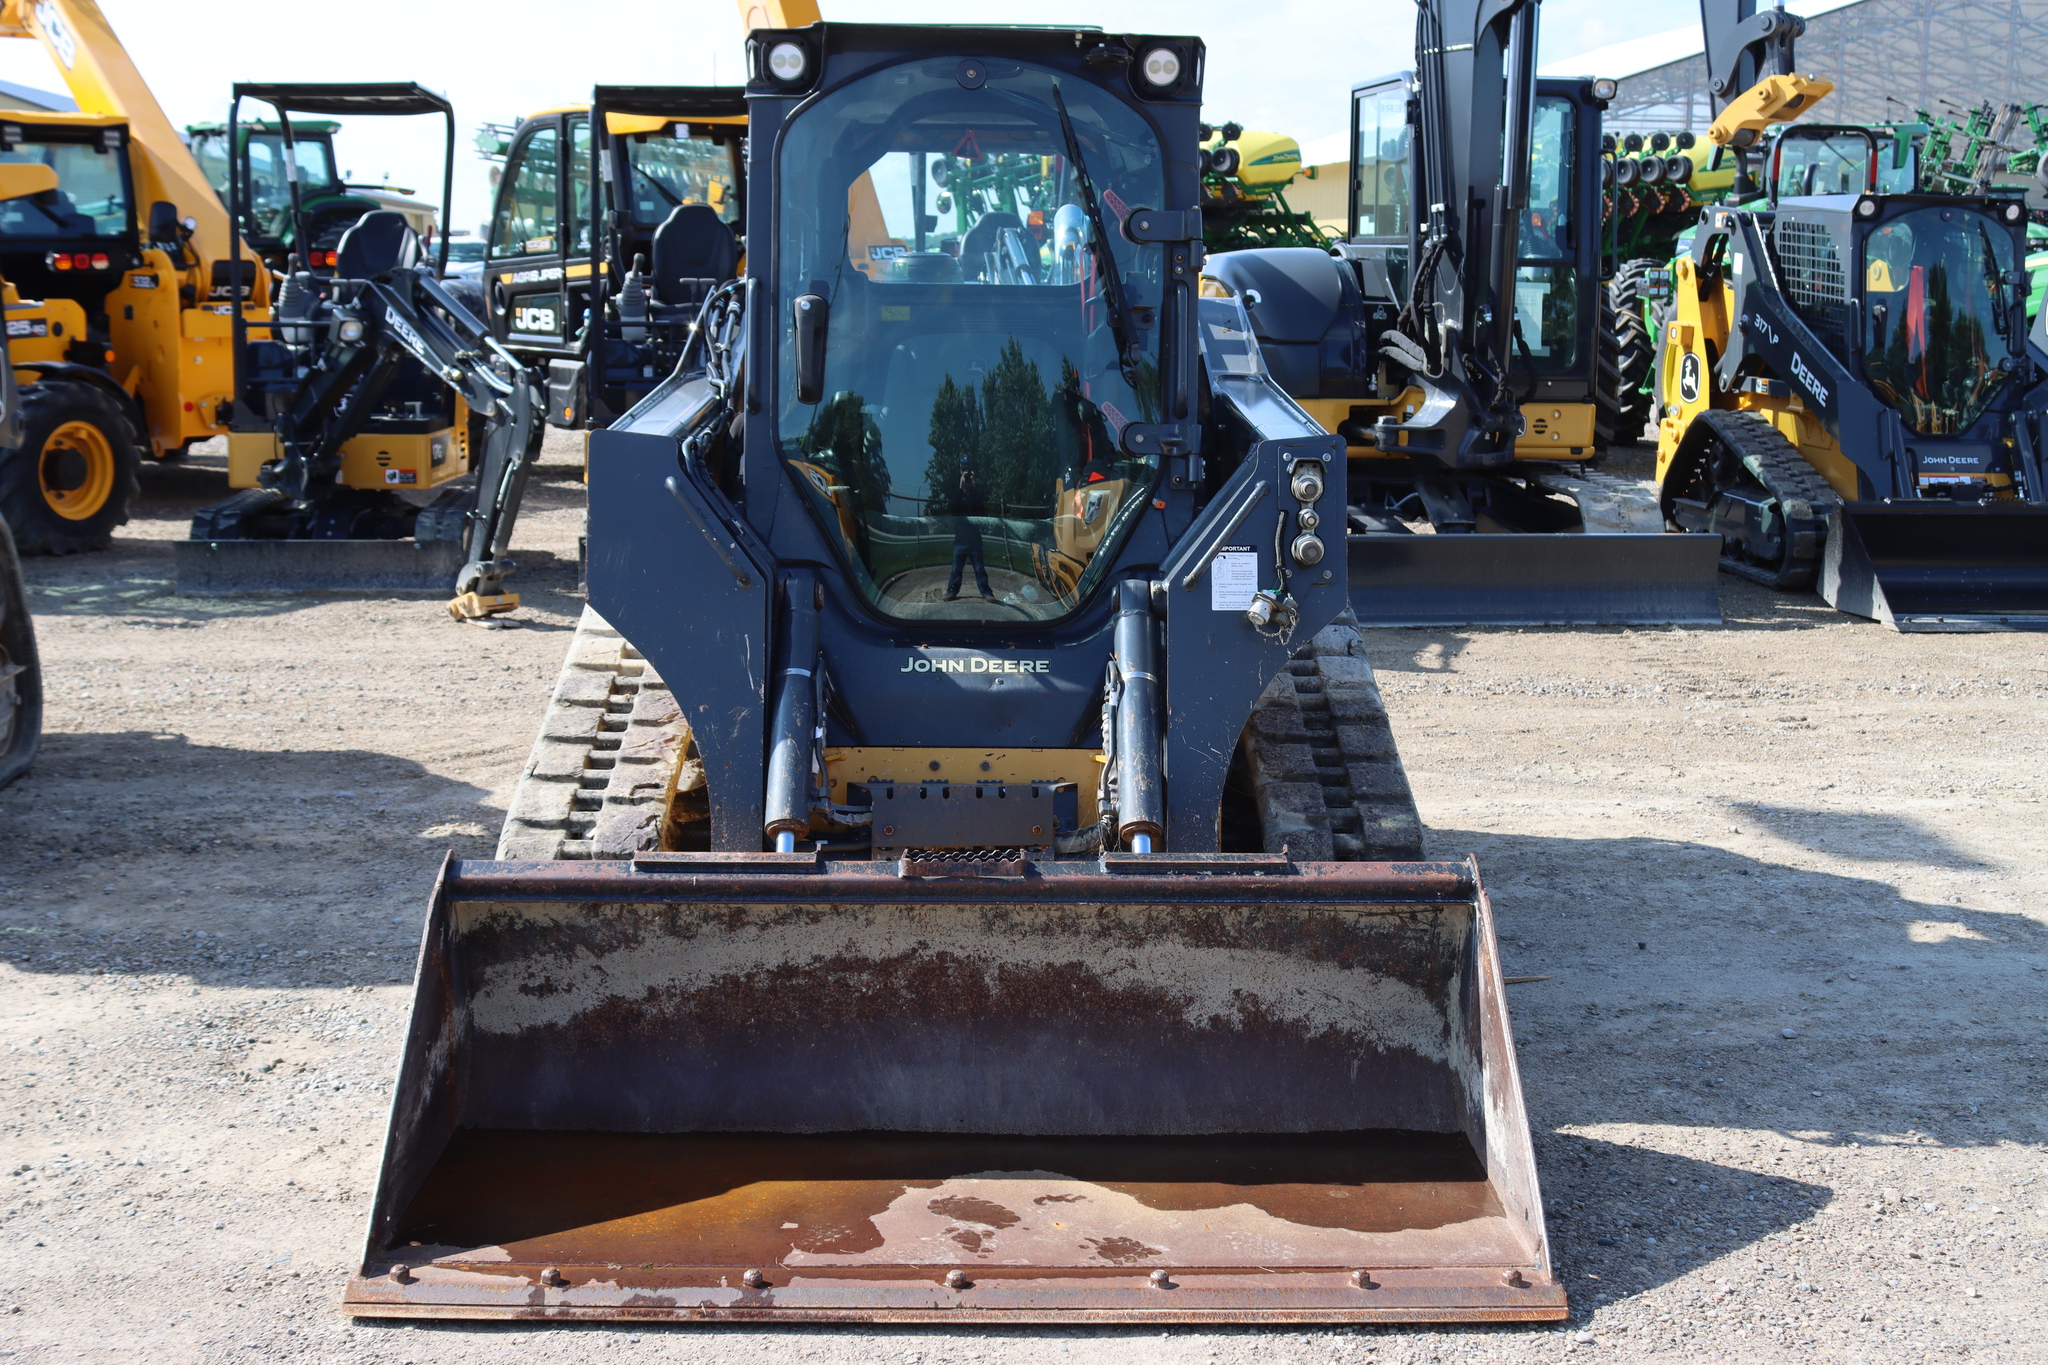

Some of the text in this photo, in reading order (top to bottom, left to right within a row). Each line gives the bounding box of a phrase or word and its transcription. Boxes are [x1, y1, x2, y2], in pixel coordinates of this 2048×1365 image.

[870, 246, 906, 260] JCB
[212, 304, 234, 315] JC
[515, 307, 555, 331] JCB
[384, 305, 425, 355] DEERE
[1790, 351, 1829, 408] DEERE
[1922, 455, 1980, 464] JOHN DEERE
[900, 655, 1050, 673] JOHN DEERE
